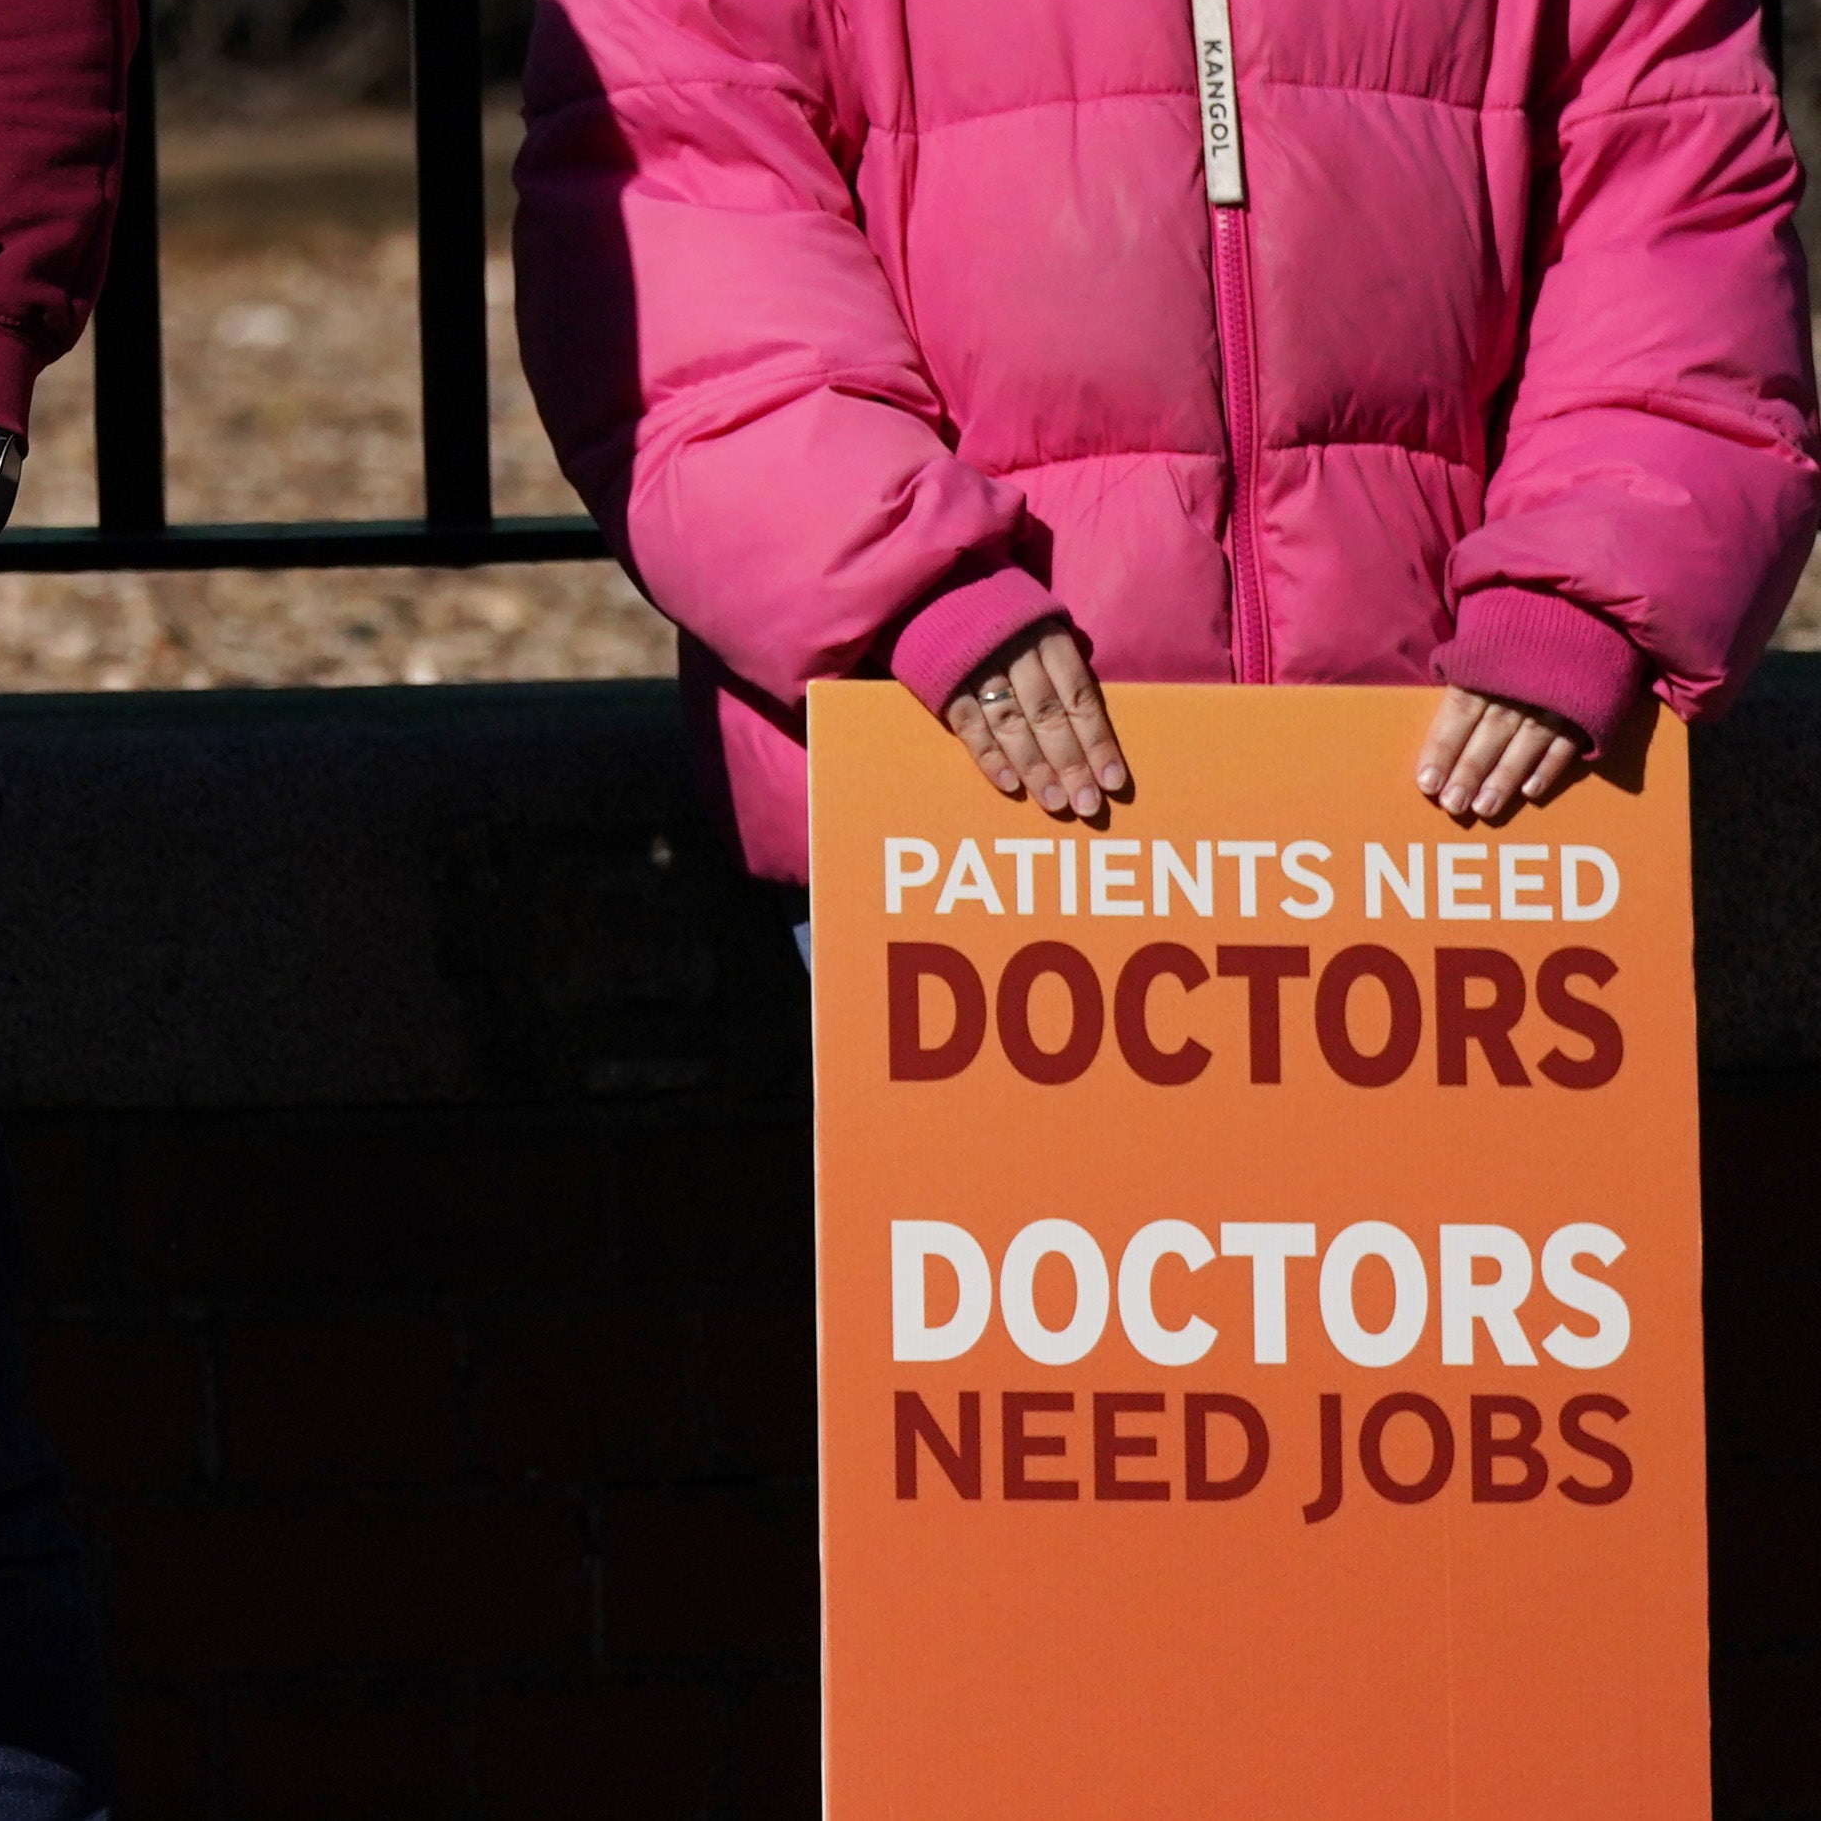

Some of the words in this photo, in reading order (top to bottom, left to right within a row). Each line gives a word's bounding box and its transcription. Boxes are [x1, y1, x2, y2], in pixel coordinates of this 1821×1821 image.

[1203, 39, 1231, 158] KANGOL
[883, 836, 1336, 920] PATIENTS
[1364, 841, 1621, 923] NEED
[885, 939, 1625, 1092] DOCTORS
[890, 1217, 1632, 1370] DOCTORS
[892, 1389, 1271, 1504] NEED
[1301, 1390, 1636, 1526] JOBS
